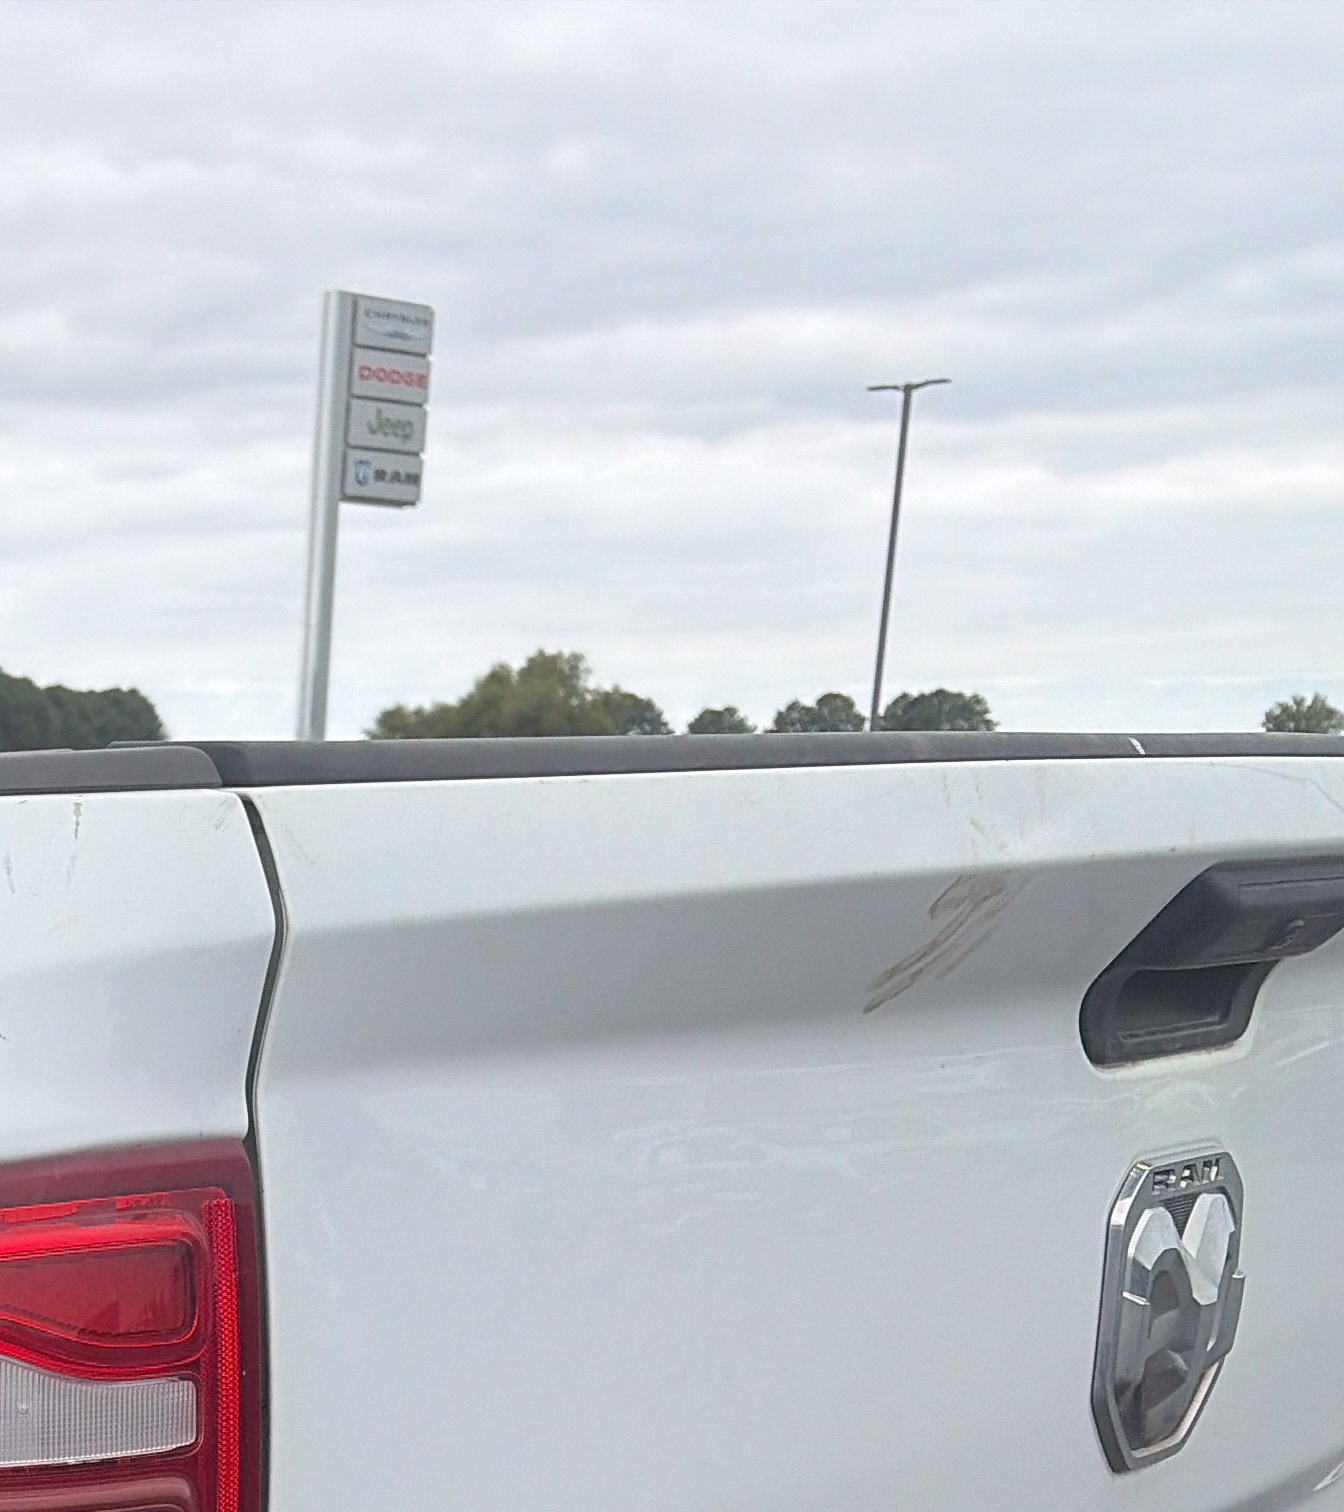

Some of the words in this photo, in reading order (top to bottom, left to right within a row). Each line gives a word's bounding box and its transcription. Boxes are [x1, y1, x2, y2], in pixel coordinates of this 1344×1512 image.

[359, 364, 428, 389] DODGE
[367, 407, 415, 444] Jeep
[373, 468, 420, 486] RAM
[1152, 1158, 1223, 1196] RAM
